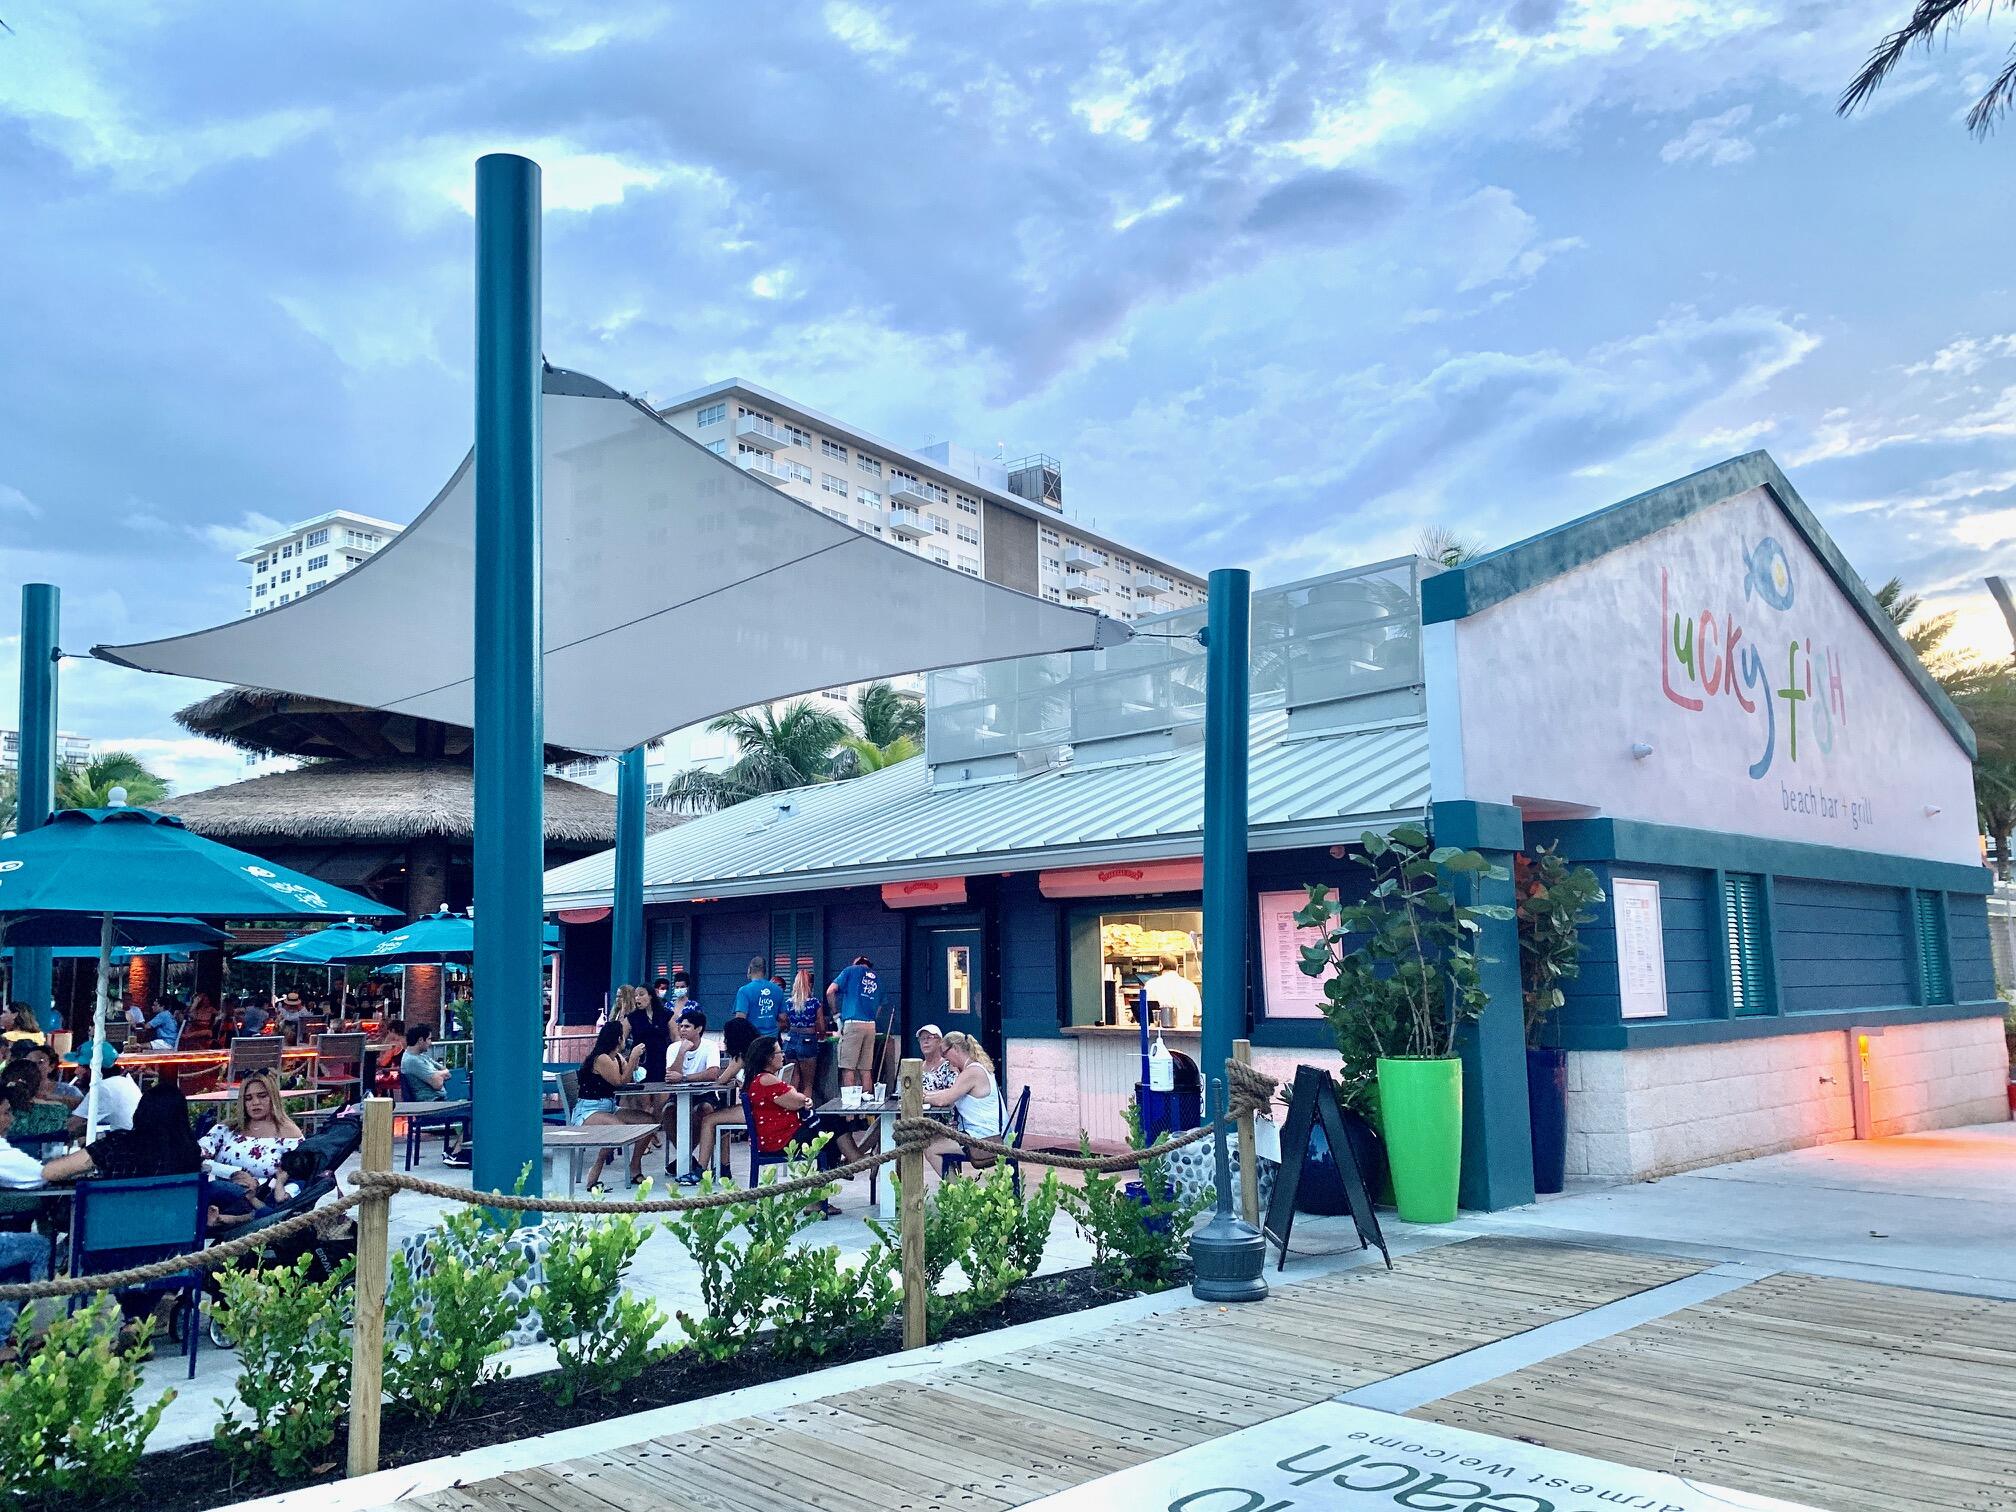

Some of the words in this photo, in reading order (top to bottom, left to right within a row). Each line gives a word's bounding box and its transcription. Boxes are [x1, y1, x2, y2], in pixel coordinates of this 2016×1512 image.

[1781, 780, 1817, 815] beach
[1820, 787, 1838, 819] bar
[1851, 796, 1873, 831] grill
[1276, 1444, 1596, 1512] each
[1348, 1431, 1515, 1478] Welcome
[1528, 1474, 1685, 1512] armest
